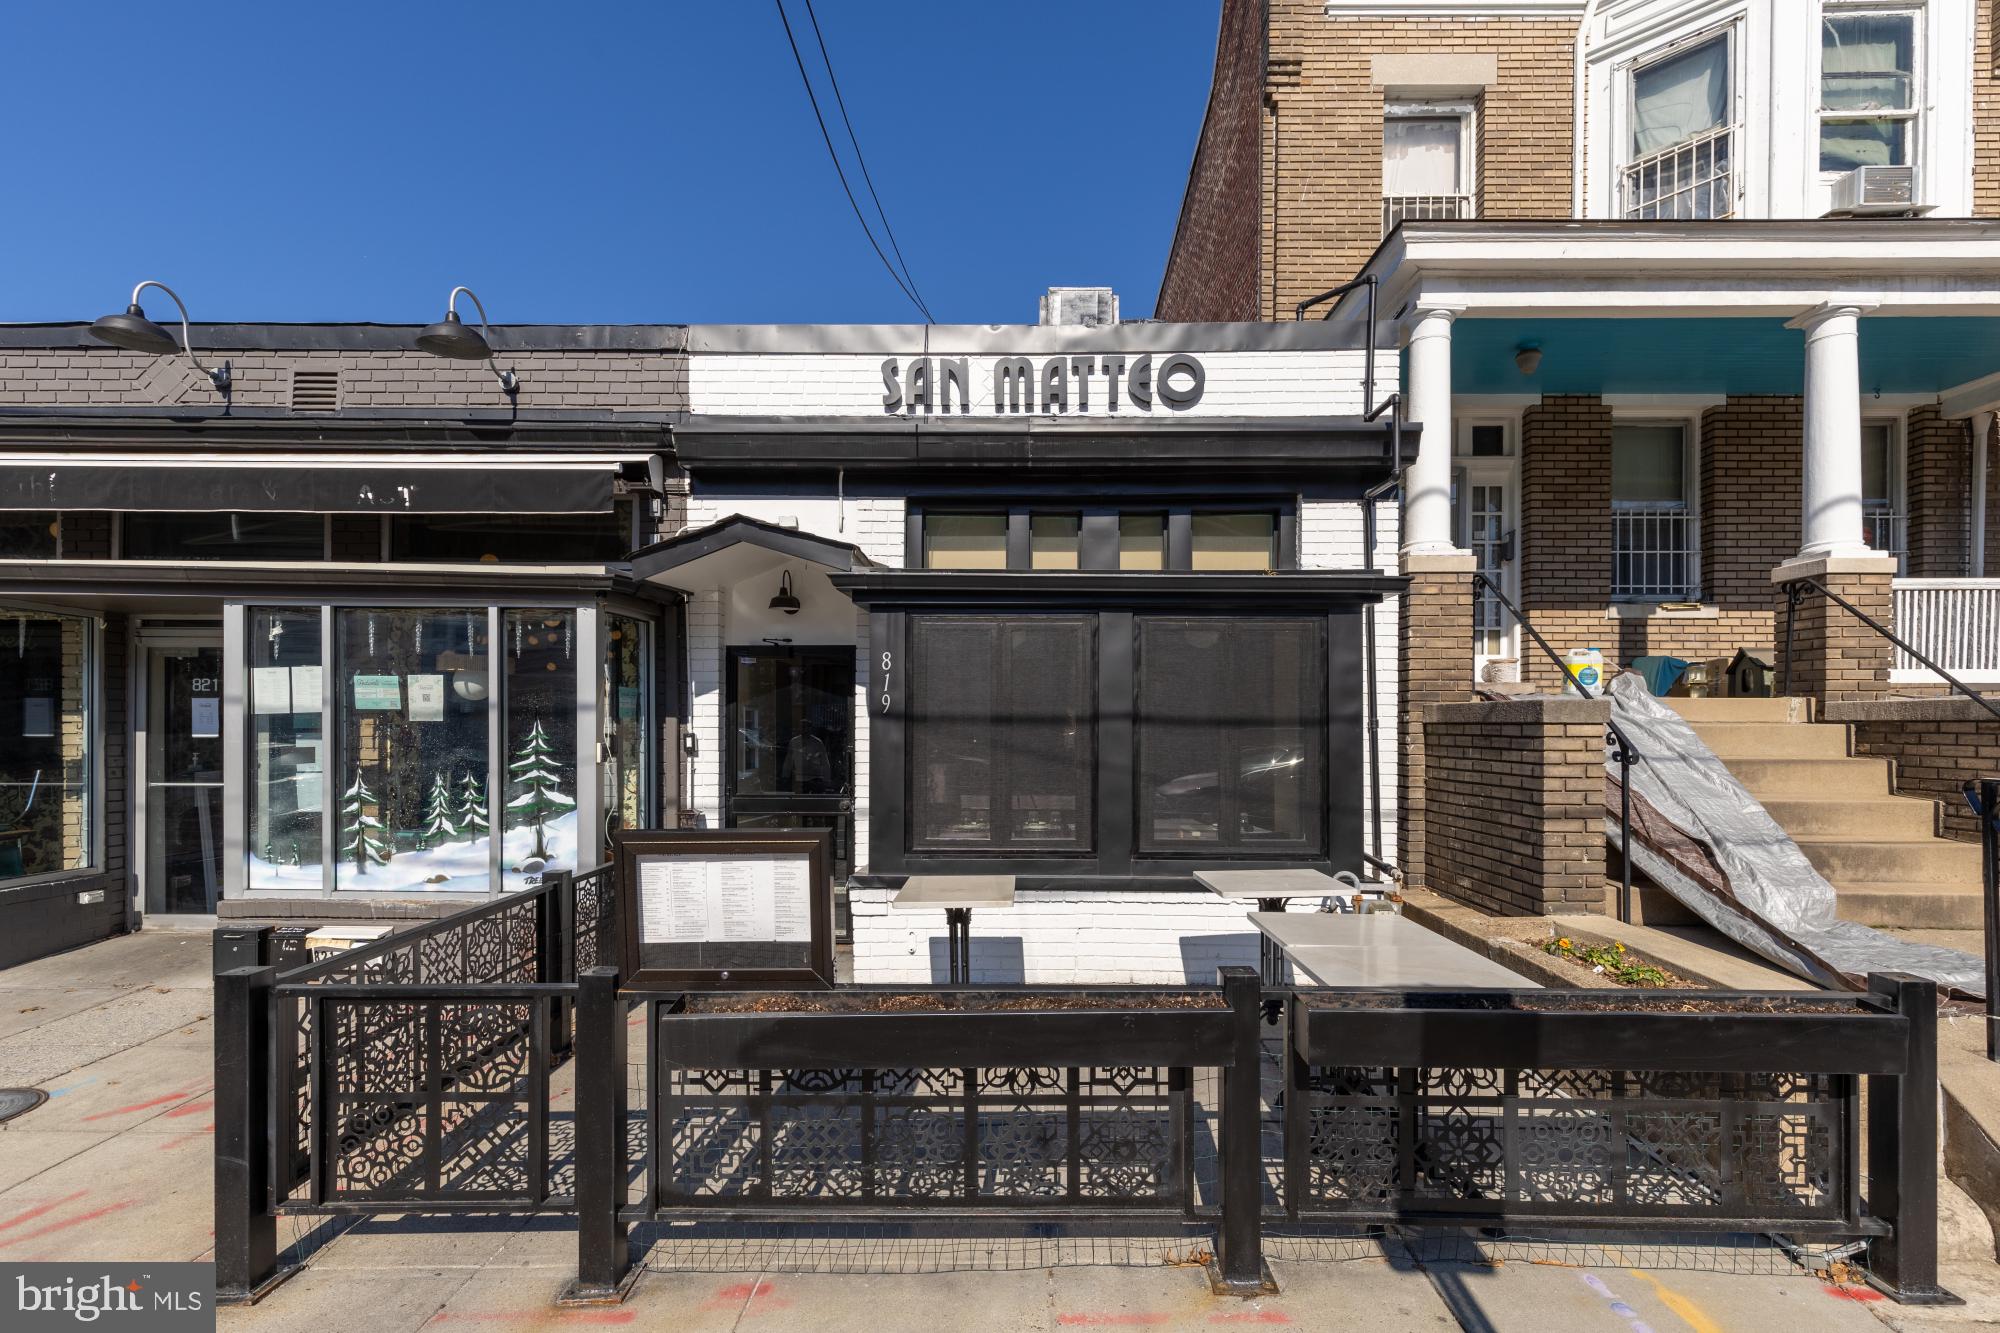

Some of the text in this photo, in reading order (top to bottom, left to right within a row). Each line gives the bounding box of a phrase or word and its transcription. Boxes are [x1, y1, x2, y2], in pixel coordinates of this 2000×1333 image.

[881, 354, 1206, 413] SAN MATTEO
[192, 678, 218, 691] 821
[881, 651, 892, 714] 819
